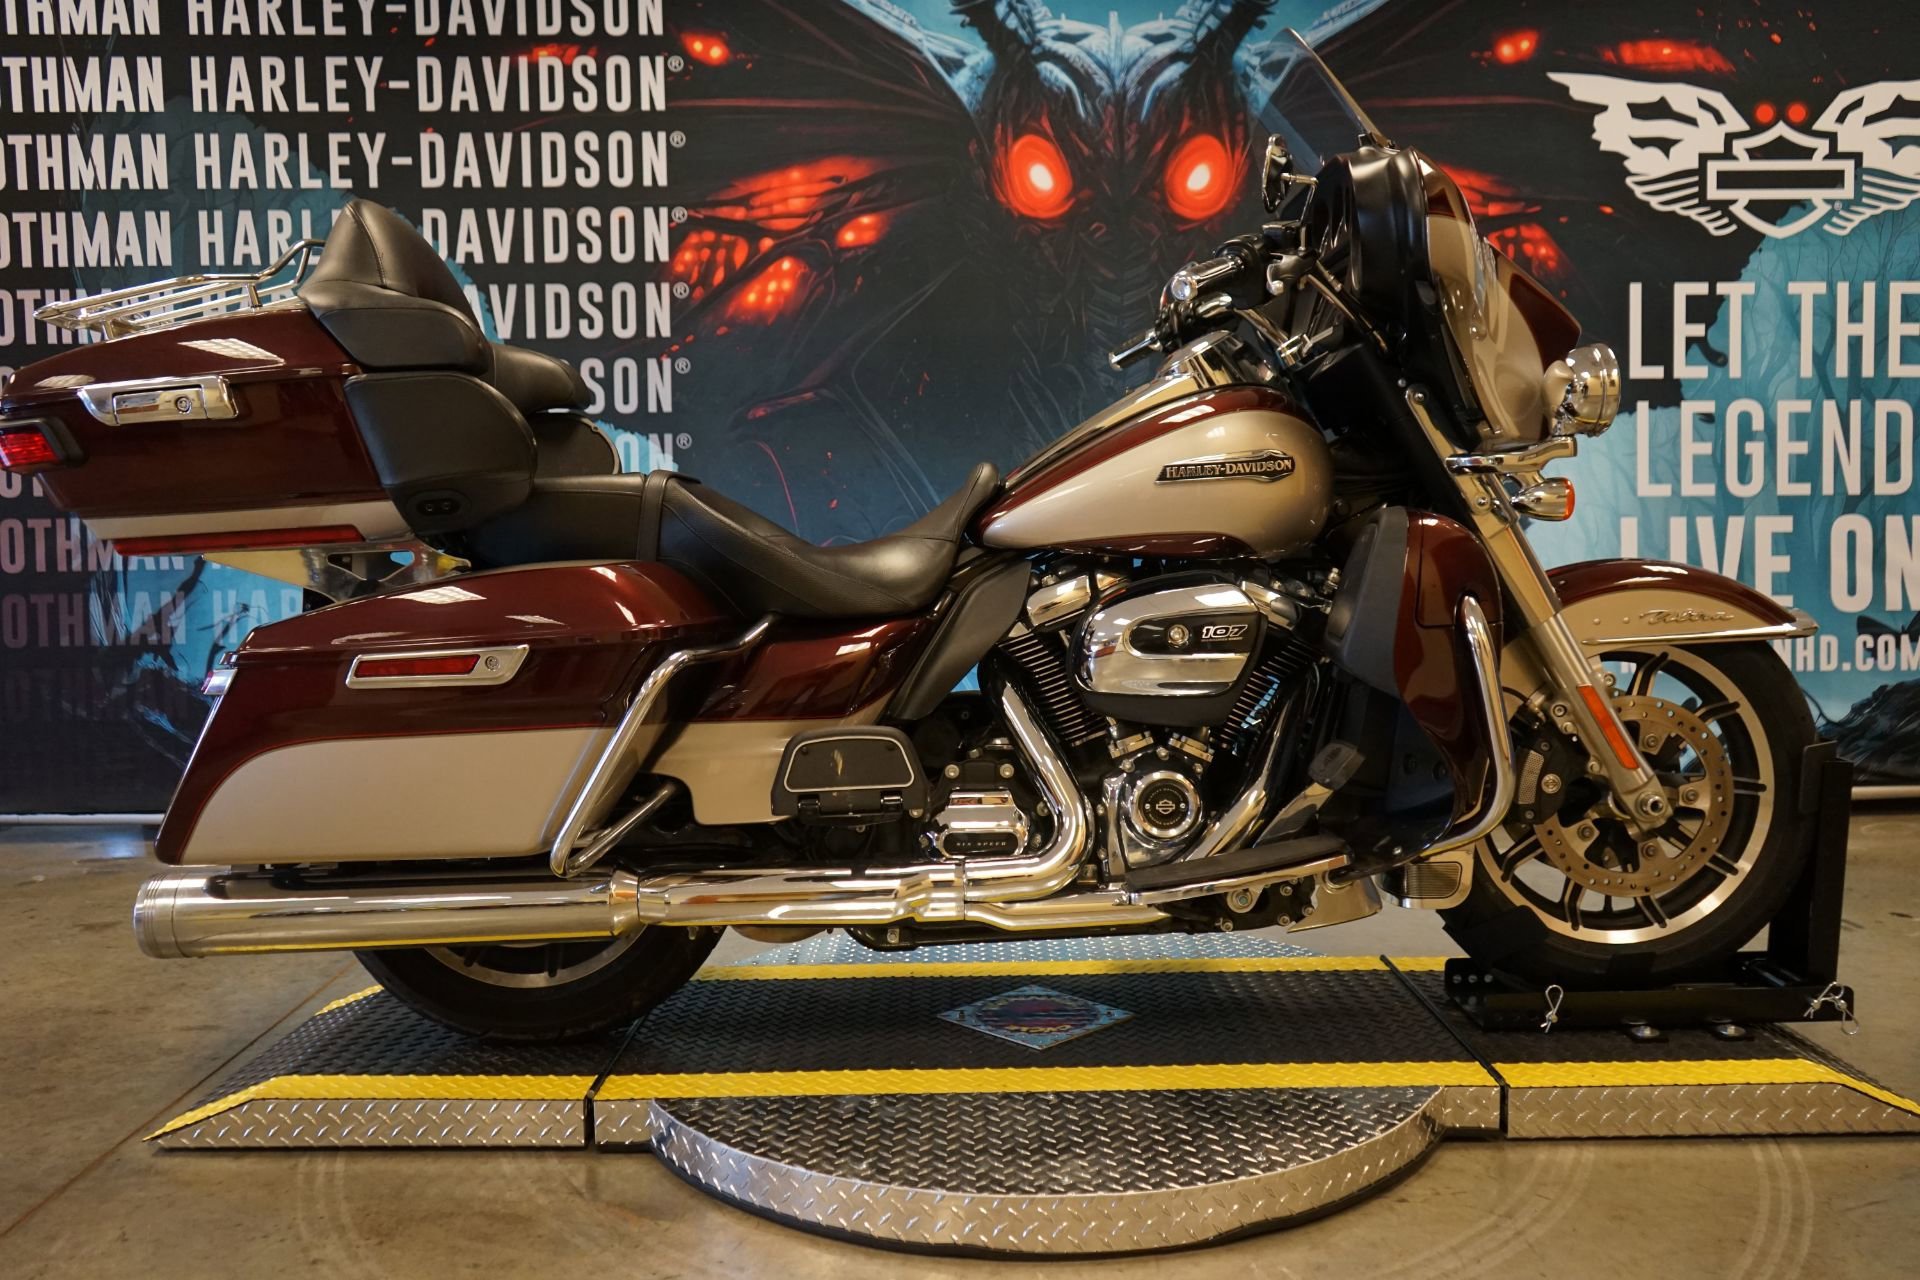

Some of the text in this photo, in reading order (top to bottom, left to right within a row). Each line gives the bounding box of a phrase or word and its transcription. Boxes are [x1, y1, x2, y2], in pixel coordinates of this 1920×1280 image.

[187, 0, 664, 36] HARLEY-DAVIDSON
[190, 54, 684, 113] HARLEY-DAVIDSON®
[0, 130, 686, 191] THMAN HARLEY-DAVIDSON®
[1629, 280, 1920, 379] LET THE
[1165, 459, 1292, 479] HARLEY-DAVIDSON
[1636, 398, 1914, 497] LEGEND
[0, 517, 184, 574] OTHM
[1830, 513, 1920, 612] ON
[1201, 624, 1249, 639] 107
